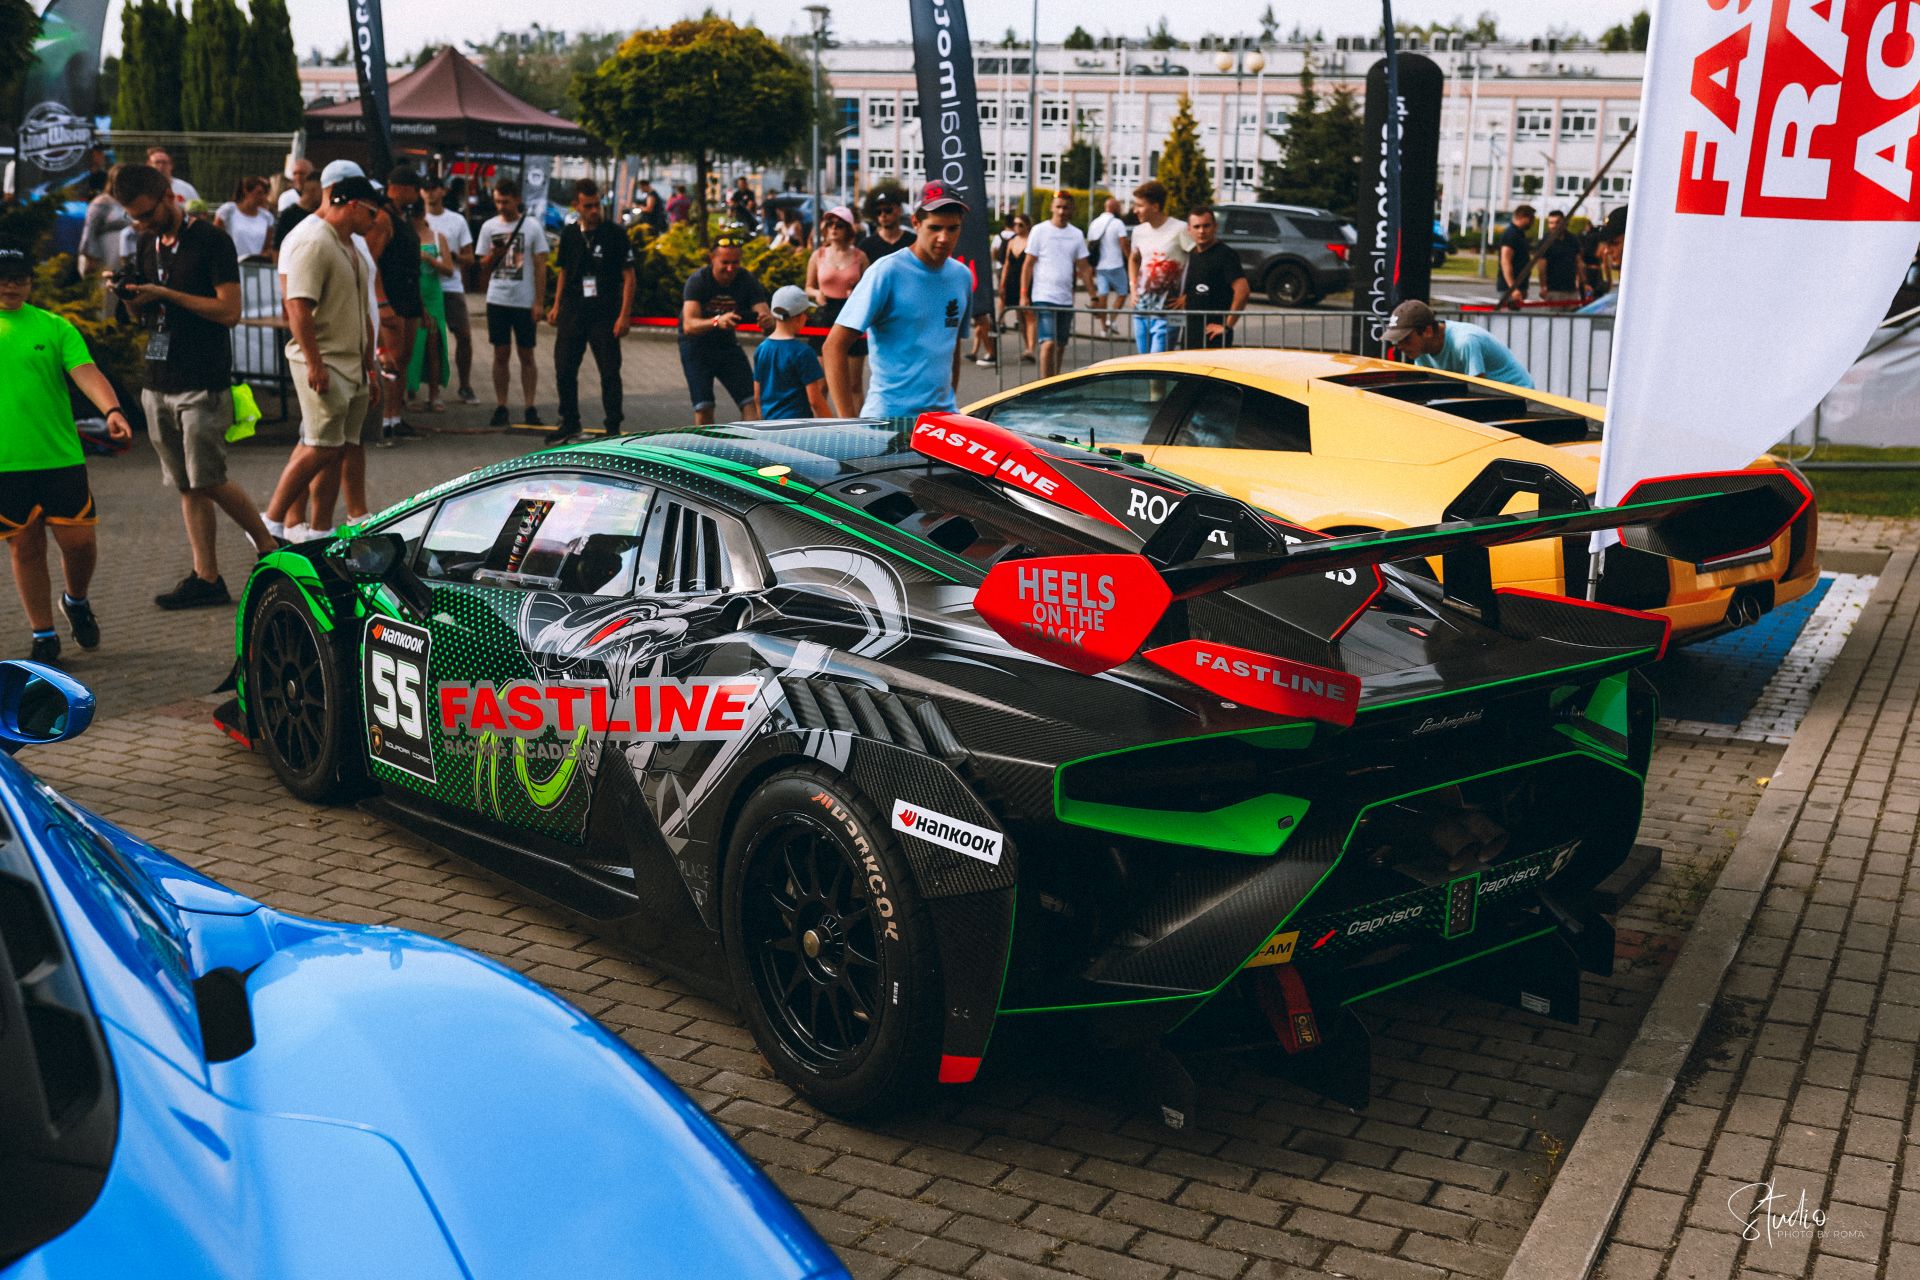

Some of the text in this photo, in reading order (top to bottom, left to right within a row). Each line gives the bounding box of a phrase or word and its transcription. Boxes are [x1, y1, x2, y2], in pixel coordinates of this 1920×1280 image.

[390, 123, 437, 135] romotion
[1675, 0, 1752, 216] FA
[547, 131, 587, 145] Promotion
[915, 423, 1060, 496] FASTLINE
[1018, 566, 1116, 611] HEELS
[1032, 602, 1105, 631] ON THE
[372, 650, 423, 740] 55
[1195, 651, 1345, 701] FASTLINE
[439, 685, 758, 733] FASTLINE
[1412, 709, 1484, 735] Lamborghini
[444, 739, 508, 758] RACING
[1347, 865, 1541, 936] Capristo Capristo
